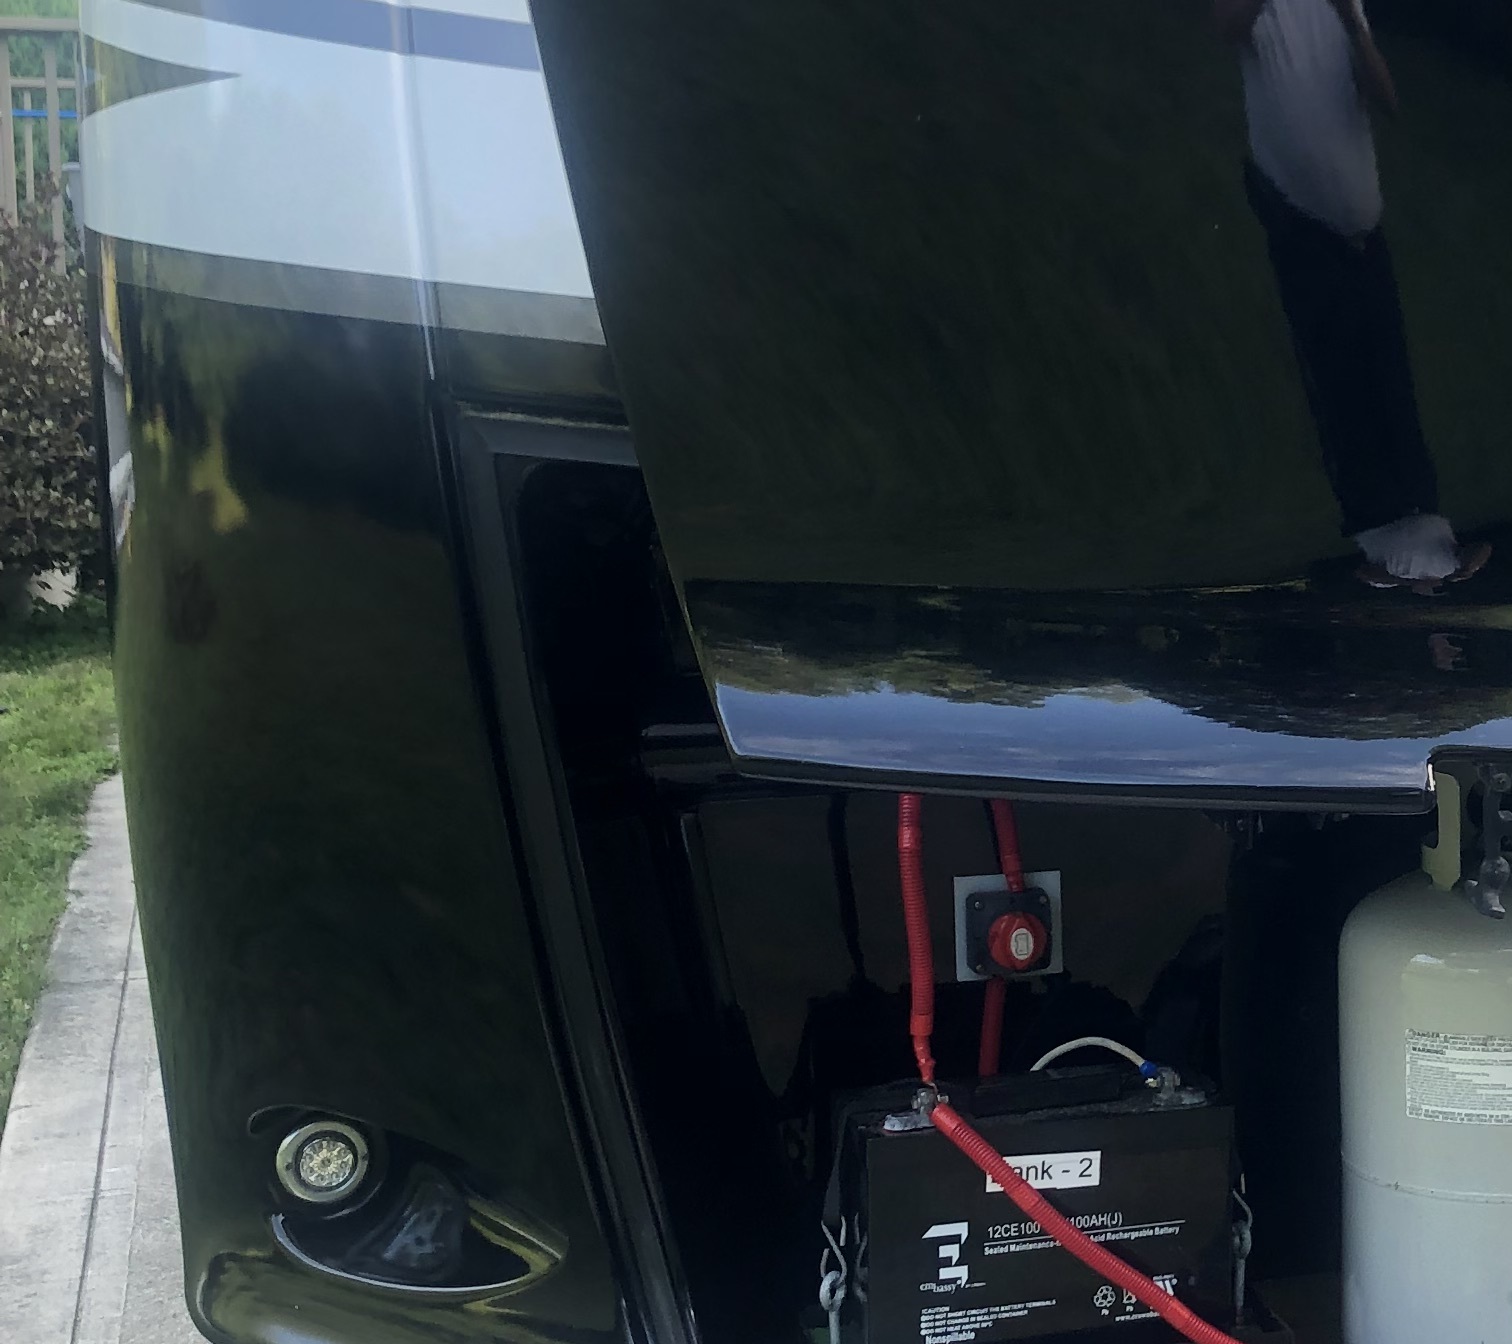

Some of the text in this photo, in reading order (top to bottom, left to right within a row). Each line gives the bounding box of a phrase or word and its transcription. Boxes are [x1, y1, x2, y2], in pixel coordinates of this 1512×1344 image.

[992, 1160, 1053, 1183] ank
[1078, 1158, 1093, 1178] 2
[984, 1245, 1009, 1256] Sealed
[1106, 1229, 1154, 1241] Rechargeable
[1154, 1225, 1180, 1236] Battery
[987, 1221, 1041, 1239] 12CE100
[925, 1331, 976, 1344] Nonspillable
